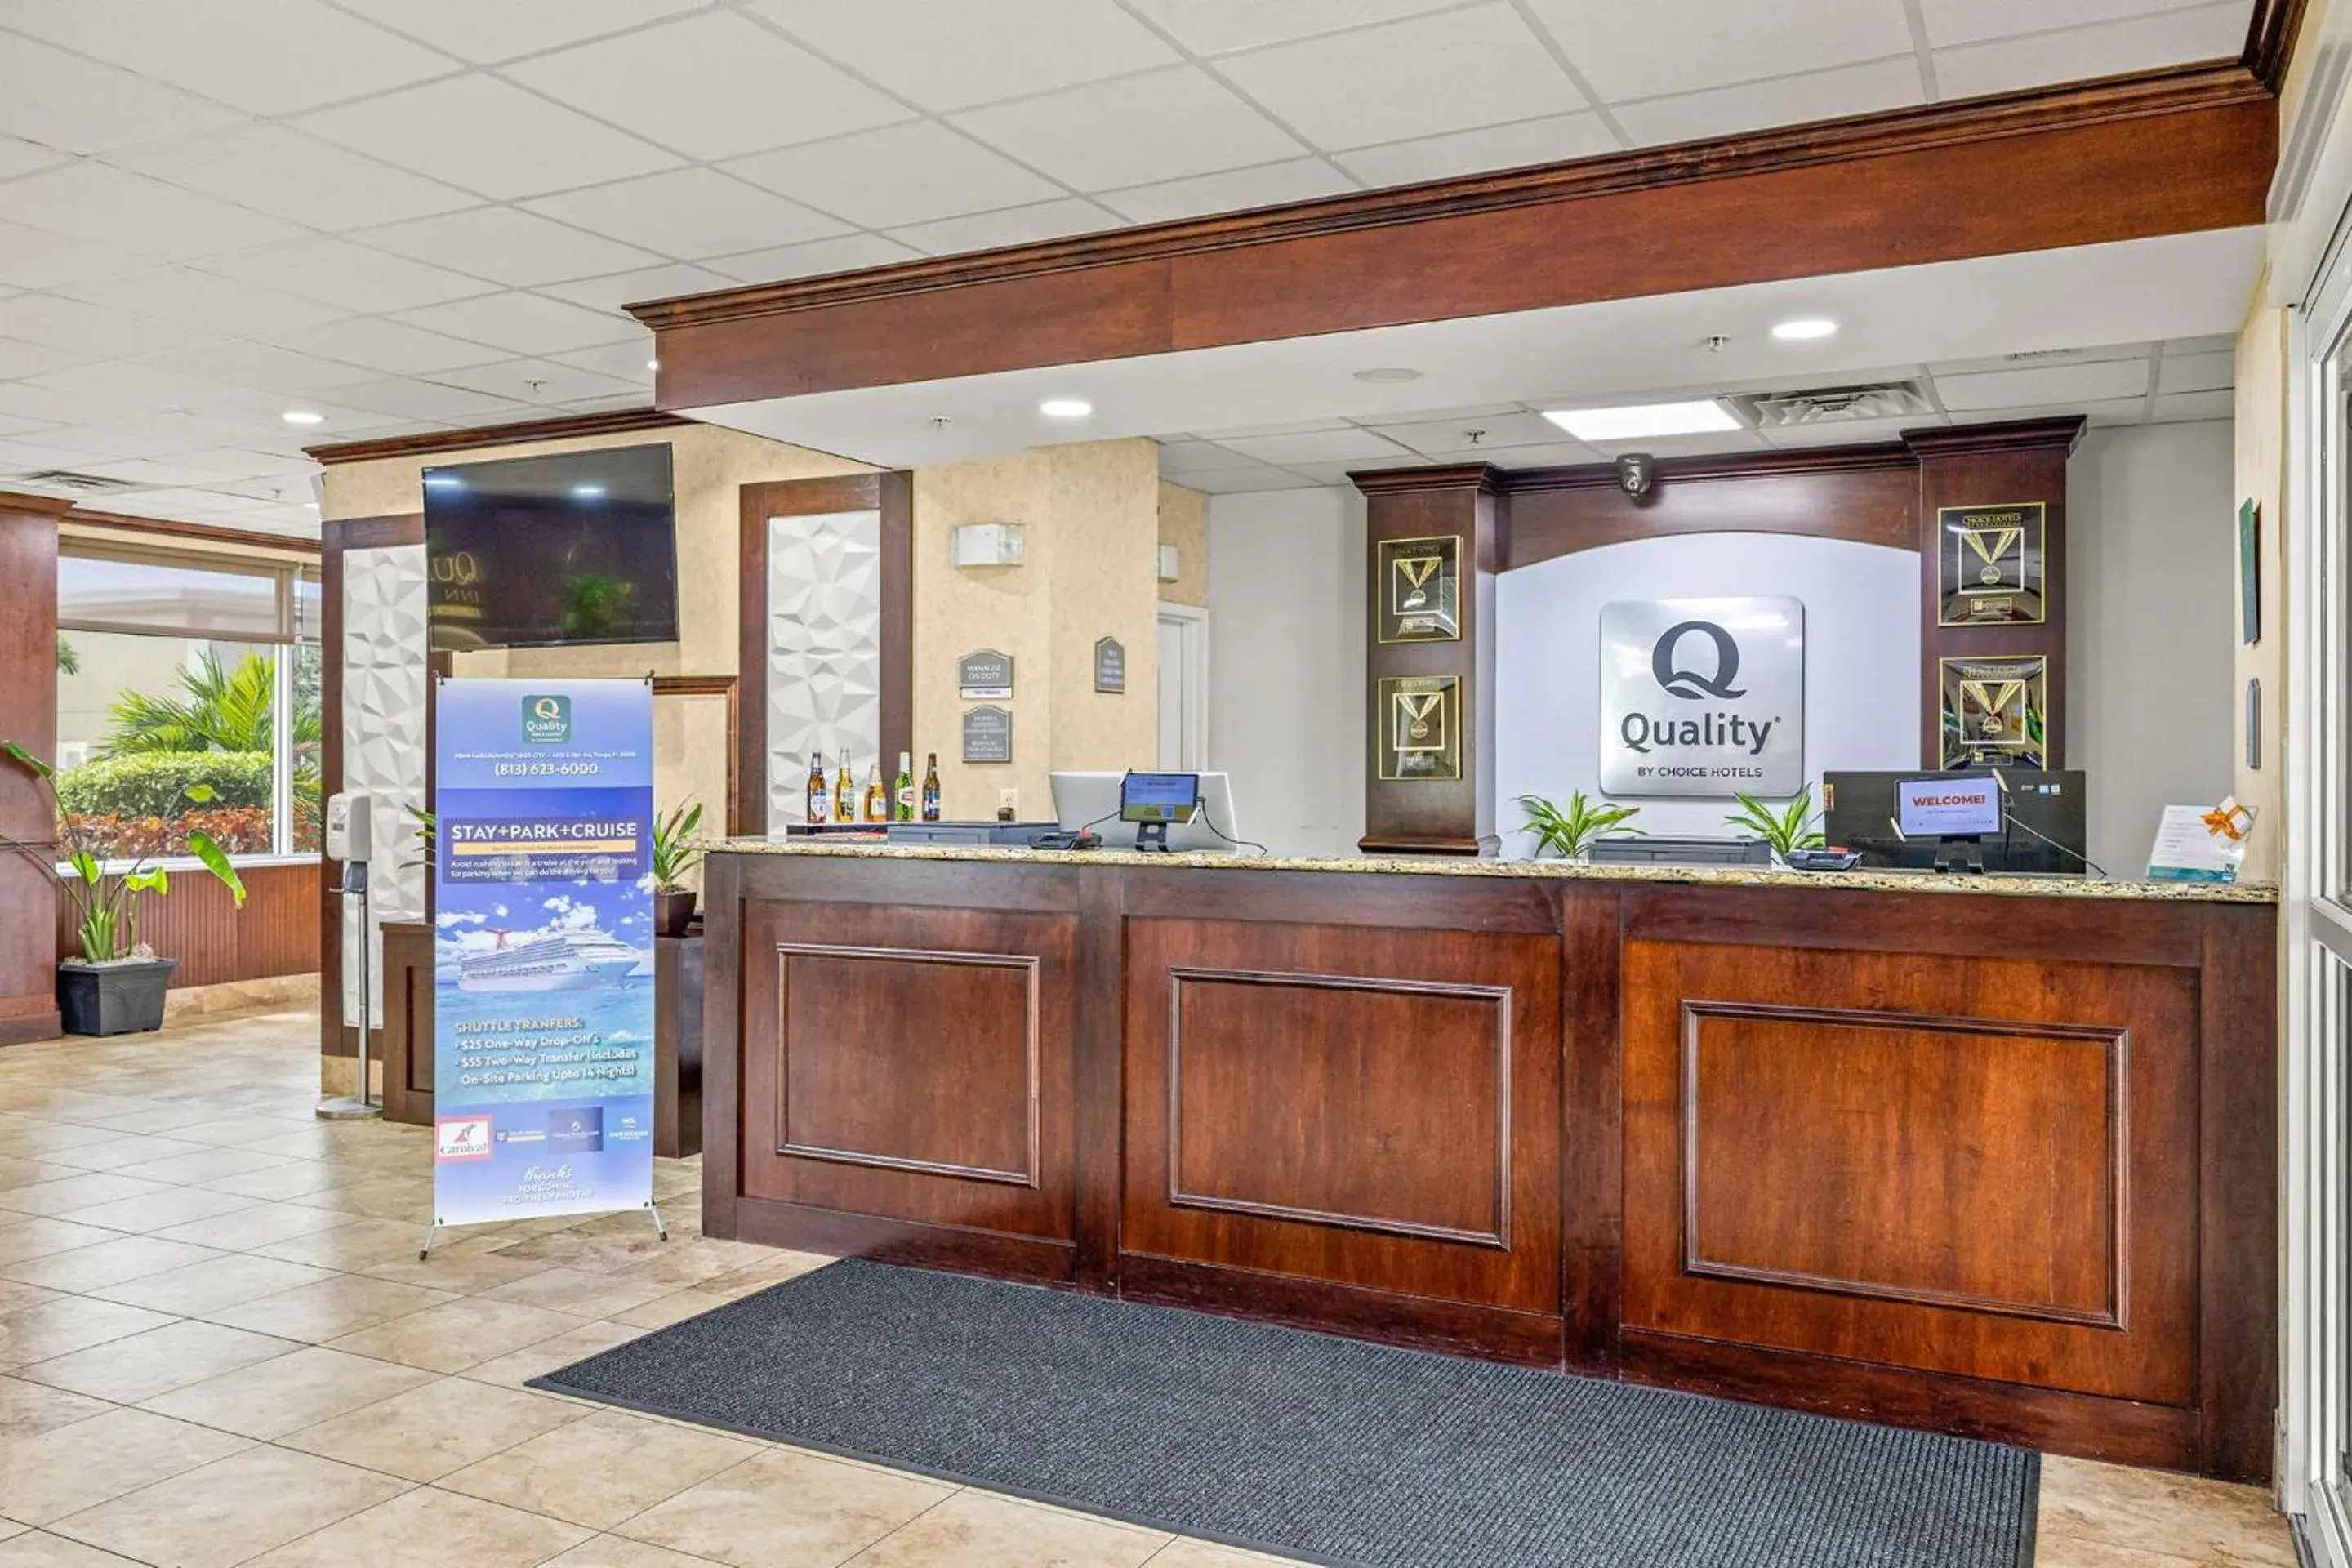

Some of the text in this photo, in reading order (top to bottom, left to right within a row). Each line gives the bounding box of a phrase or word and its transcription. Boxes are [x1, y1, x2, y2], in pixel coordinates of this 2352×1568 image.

[1652, 620, 1748, 700] Q
[535, 697, 561, 719] Q
[526, 720, 567, 733] Quality
[494, 762, 599, 777] (813) 623-6000
[1638, 767, 1762, 778] BY CHOICE HOTELS
[1912, 795, 1986, 807] WELCOME!
[451, 860, 472, 868] Avoid
[473, 861, 501, 870] rushing
[612, 856, 638, 866] looking
[462, 869, 490, 879] parking
[491, 869, 512, 877] when
[454, 1019, 514, 1032] SHUTTLE
[461, 1039, 482, 1050] $25
[539, 1053, 583, 1063] Transfer
[461, 1072, 505, 1085] On-Site
[507, 1071, 550, 1083] Parking
